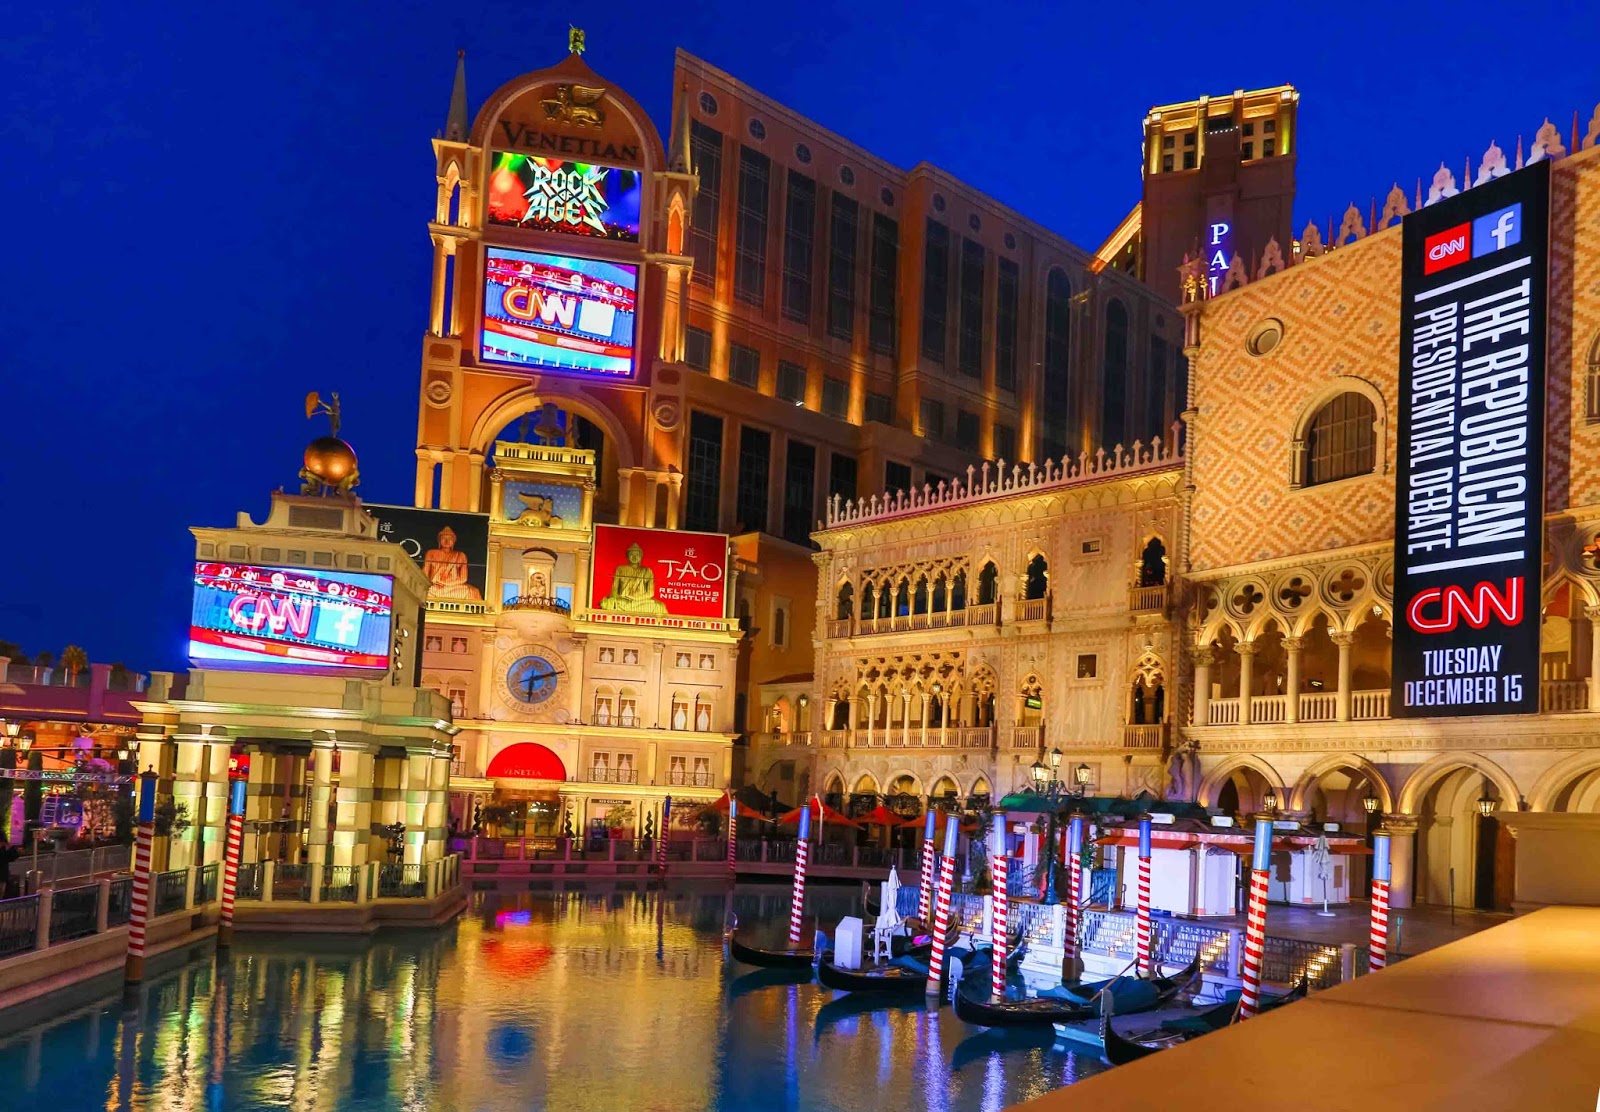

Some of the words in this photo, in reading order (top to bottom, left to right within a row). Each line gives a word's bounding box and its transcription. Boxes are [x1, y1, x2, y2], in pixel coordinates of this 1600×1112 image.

[502, 121, 639, 160] VENETIAN
[523, 158, 610, 210] ROCK
[558, 189, 575, 202] OF
[521, 191, 608, 237] AGES
[1428, 235, 1465, 262] CNN
[503, 286, 576, 329] CNN
[1463, 277, 1530, 352] THE
[1410, 302, 1457, 468] PRESIDENTIAL
[1457, 344, 1527, 547] REPUBLICAN
[1407, 465, 1453, 555] DEBATE
[658, 560, 722, 581] TAO
[668, 581, 712, 589] NIGHTCLUB
[659, 587, 719, 597] RELIGIOUS
[660, 593, 718, 603] NIGHTLIFE
[1405, 576, 1525, 635] CNN
[228, 592, 314, 638] CNN
[1423, 644, 1502, 677] TUESDAY
[1404, 673, 1497, 707] DECEMBER
[1502, 674, 1523, 703] 15
